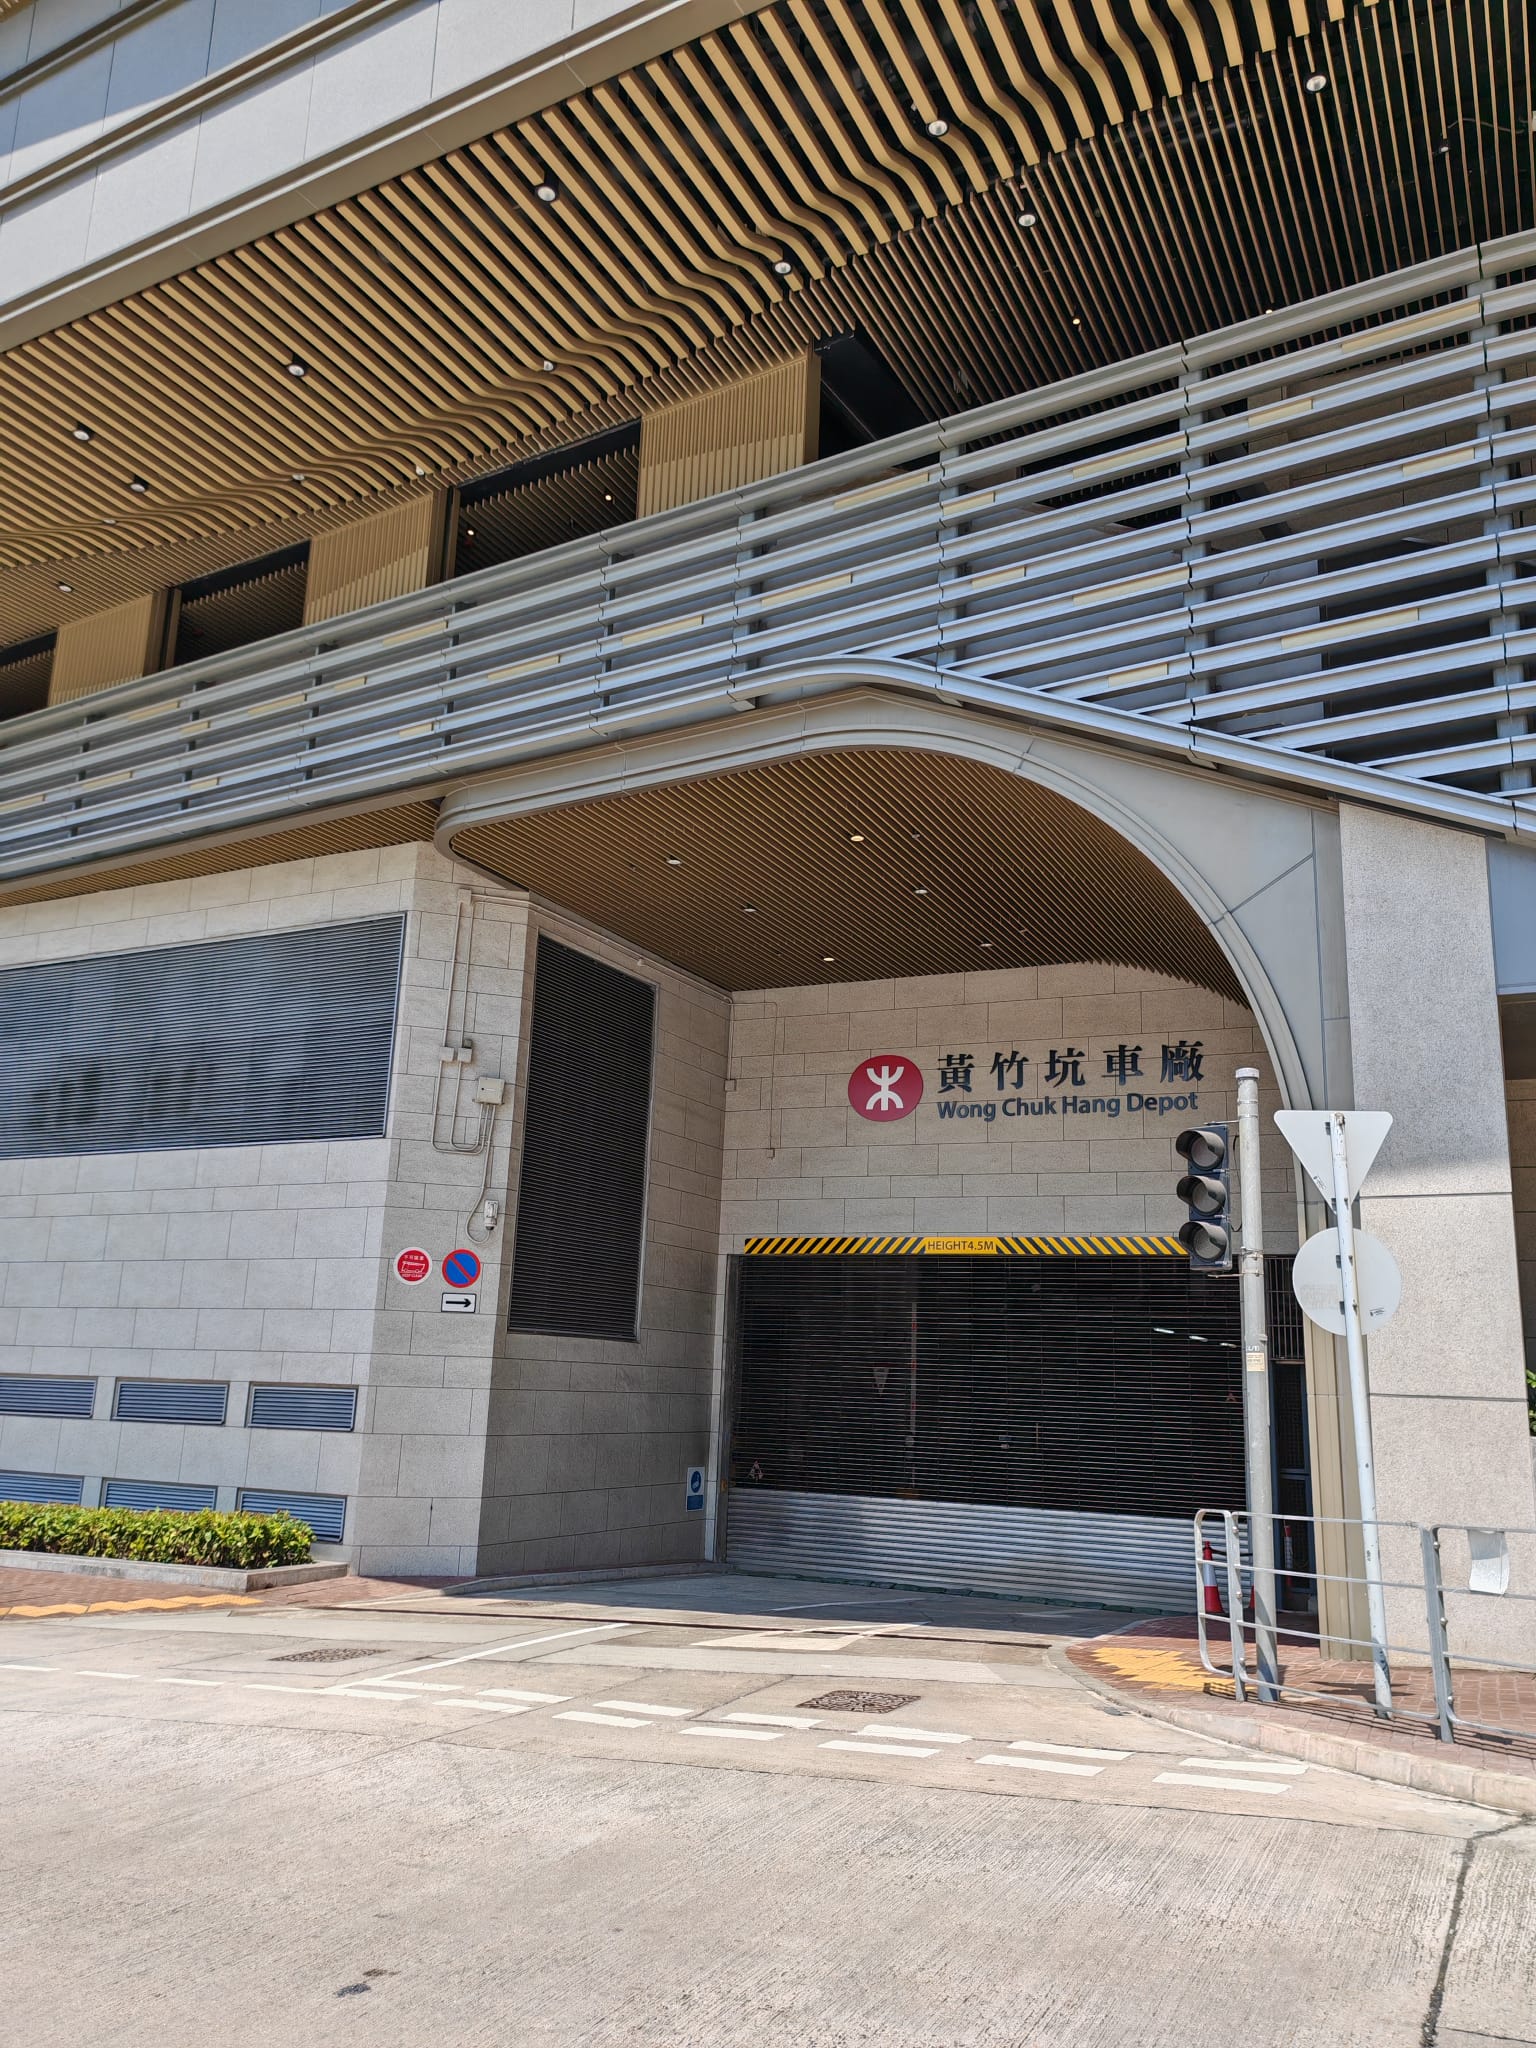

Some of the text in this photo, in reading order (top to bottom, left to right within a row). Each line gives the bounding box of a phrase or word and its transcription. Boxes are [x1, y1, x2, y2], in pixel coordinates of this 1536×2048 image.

[937, 1040, 1205, 1093] 黃竹坑車廠
[937, 1092, 1198, 1122] Wong Chuk Hang Depot
